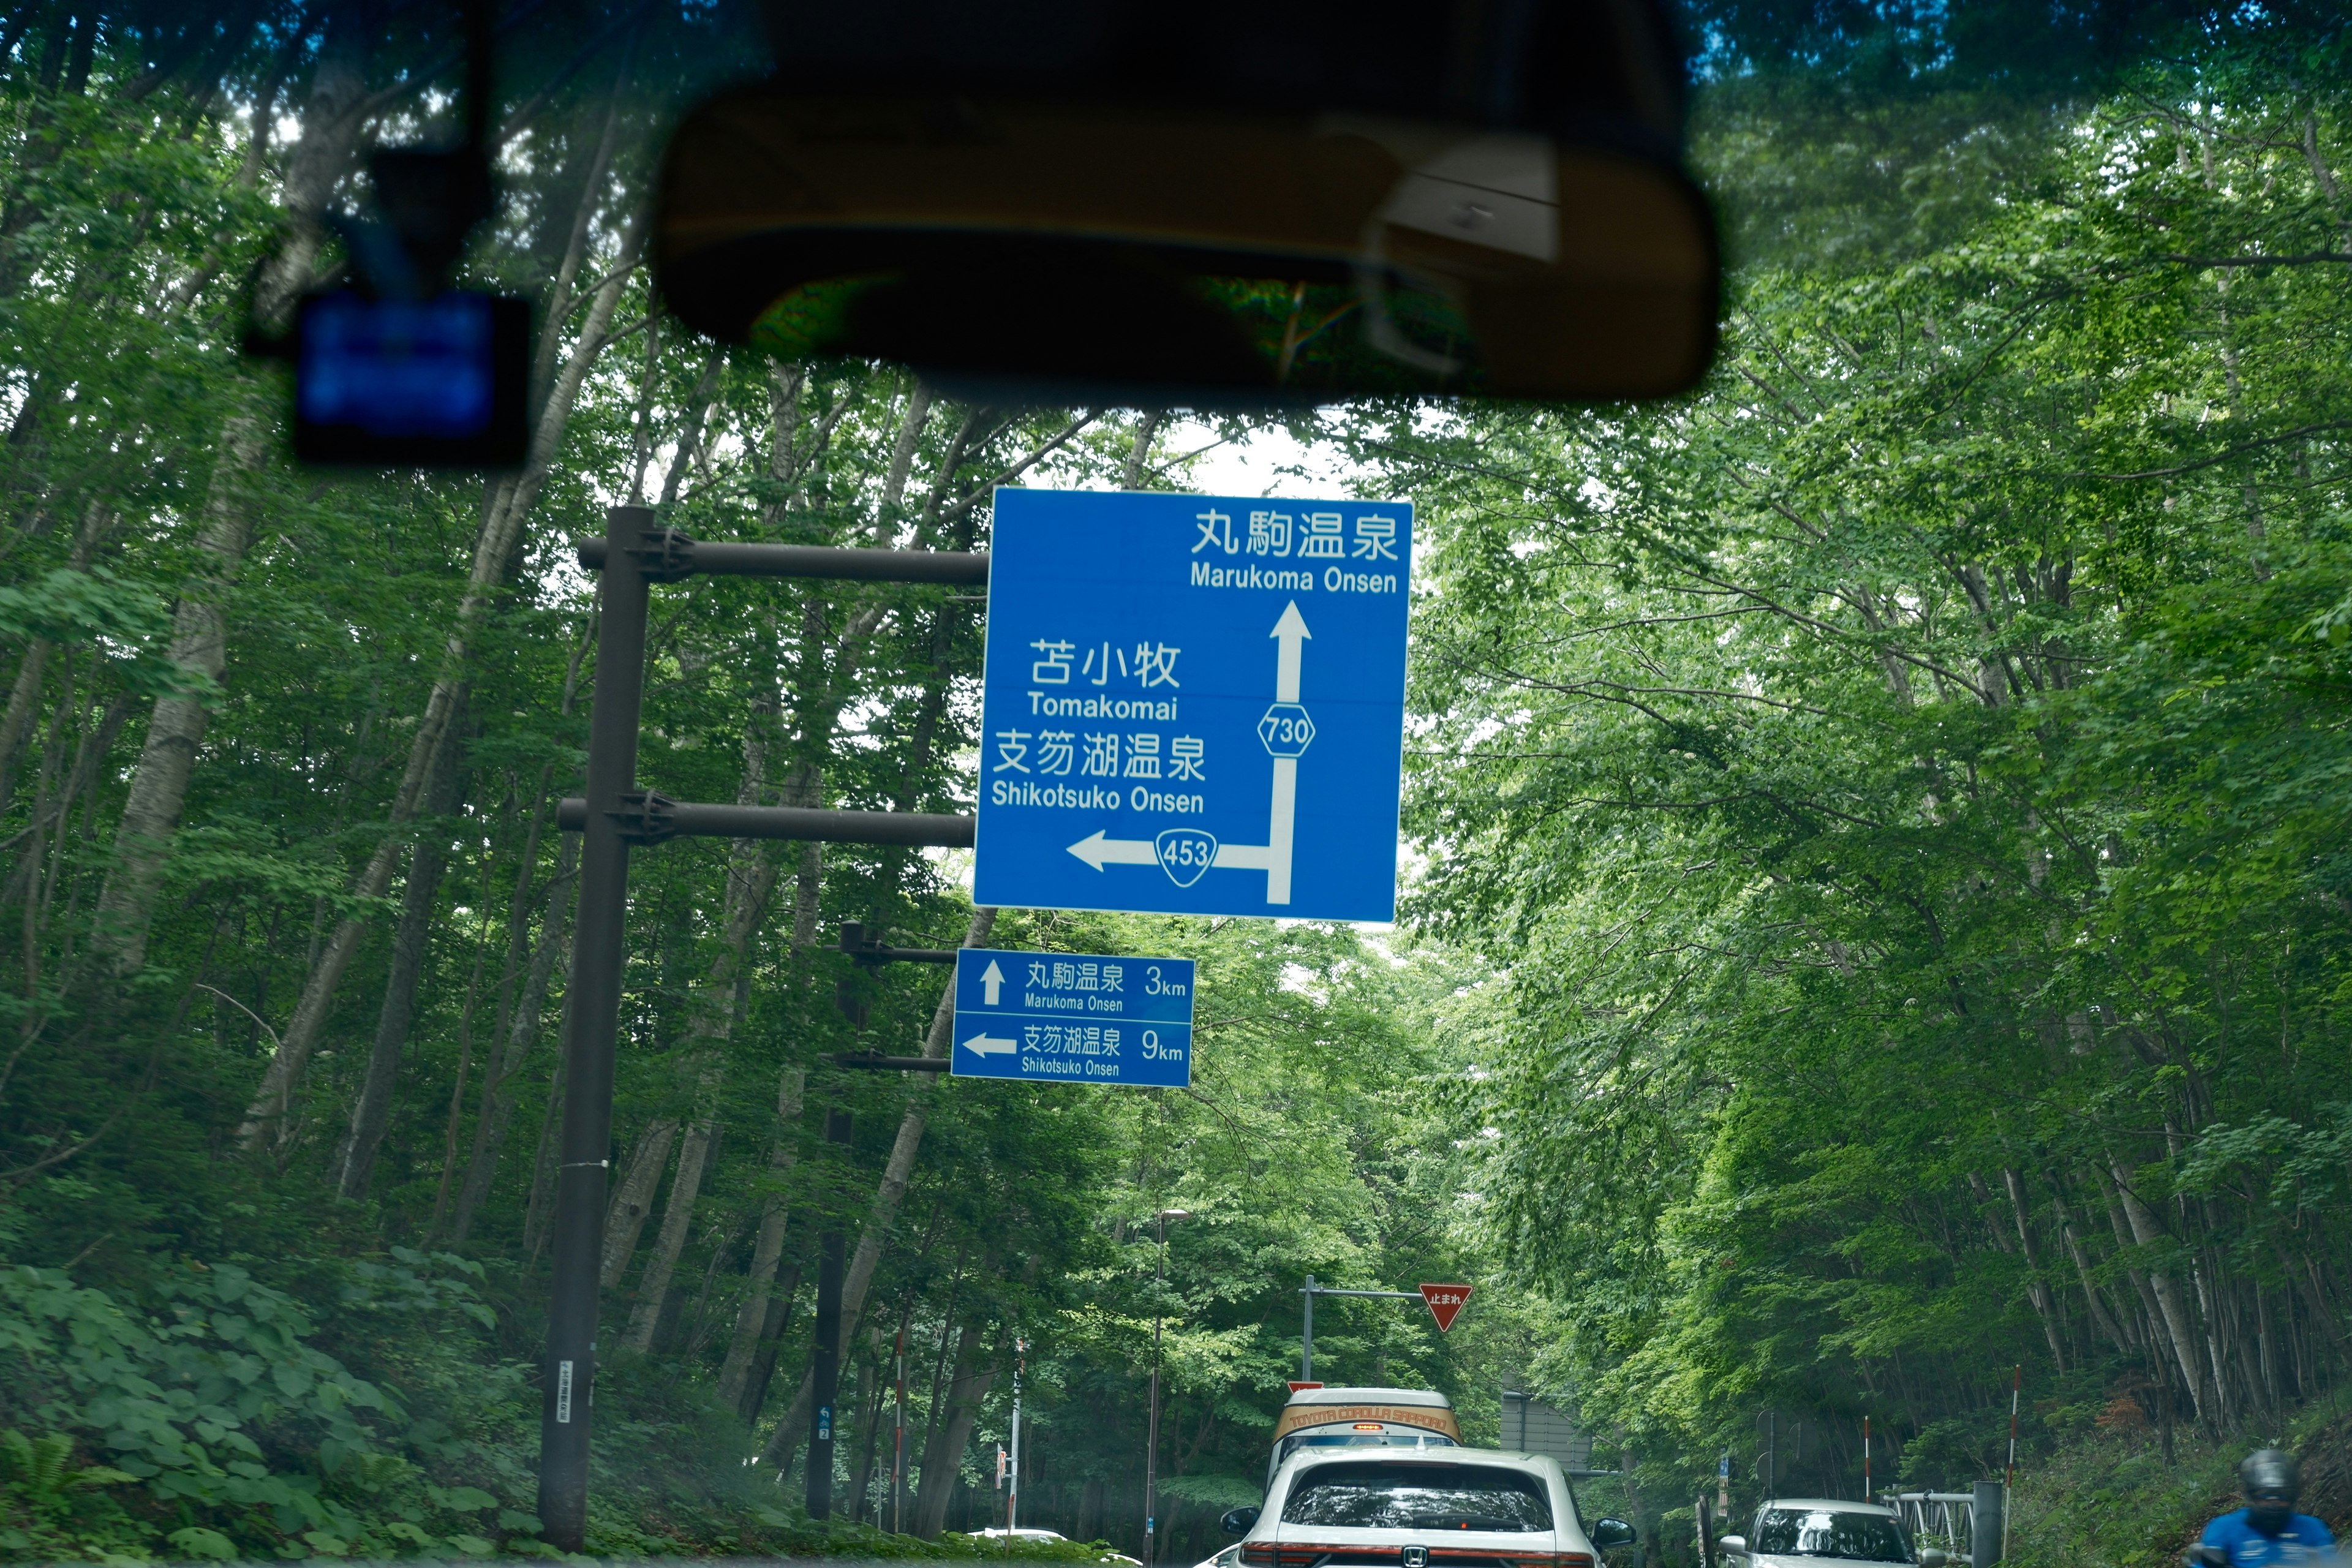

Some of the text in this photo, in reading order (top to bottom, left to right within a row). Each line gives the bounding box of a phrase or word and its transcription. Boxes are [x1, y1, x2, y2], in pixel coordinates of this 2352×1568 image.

[1192, 509, 1398, 560] 丸駒温泉
[1191, 562, 1396, 594] Marukoma Onsen
[1030, 639, 1181, 688] 苫小牧
[1027, 692, 1177, 720] Tomakomai
[1265, 717, 1308, 744] 730
[993, 728, 1205, 781] 支笏湖温泉
[992, 780, 1204, 813] Shikotsuko Onsen
[1164, 840, 1208, 865] 453
[1025, 961, 1124, 992] 丸駒温泉
[1025, 992, 1123, 1012] Marukoma Onsen
[1022, 1024, 1120, 1057] 支笏湖温泉
[1022, 1056, 1120, 1077] Shikotsuko Onsen
[1430, 1293, 1461, 1305] 止まれ
[1290, 1408, 1447, 1430] TOYOTA COROLLA SAPPORO
